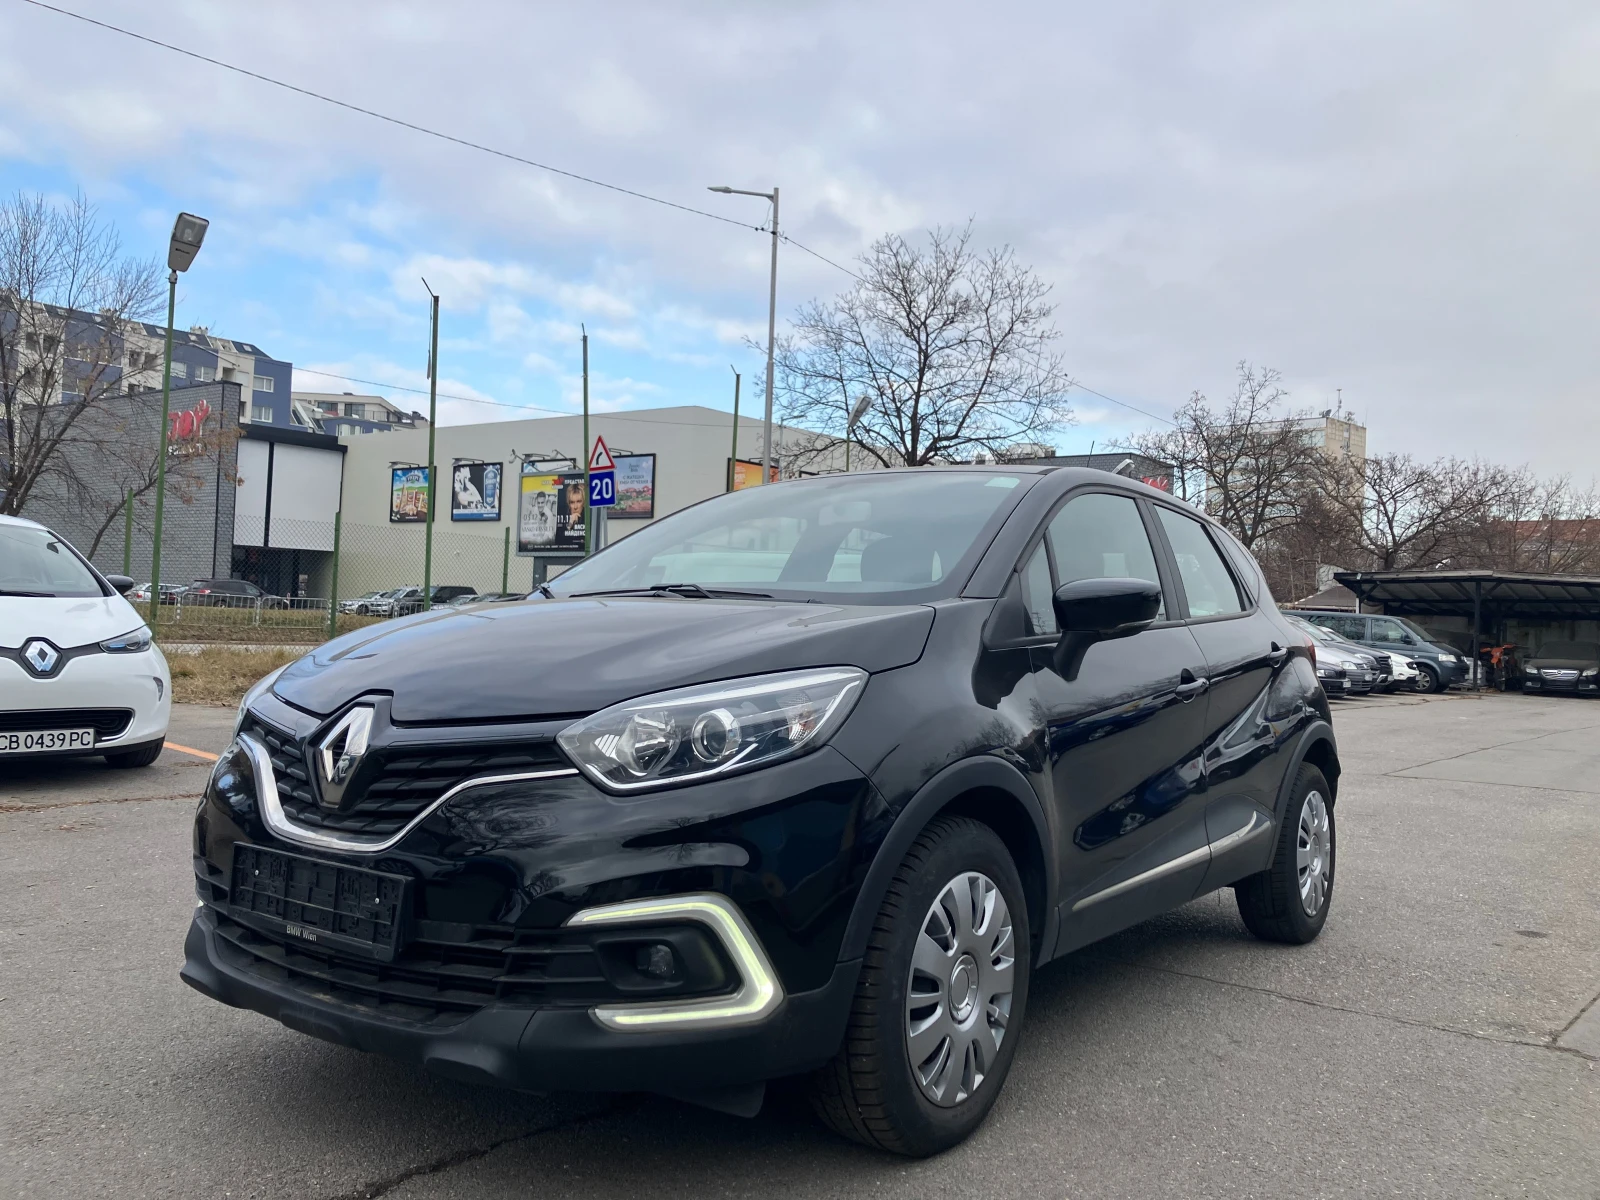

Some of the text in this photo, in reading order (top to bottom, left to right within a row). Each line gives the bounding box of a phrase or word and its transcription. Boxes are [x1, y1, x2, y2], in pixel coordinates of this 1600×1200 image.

[592, 478, 612, 500] 20
[24, 732, 66, 749] 0439
[69, 731, 91, 747] PC
[286, 925, 317, 941] BMW Wien
